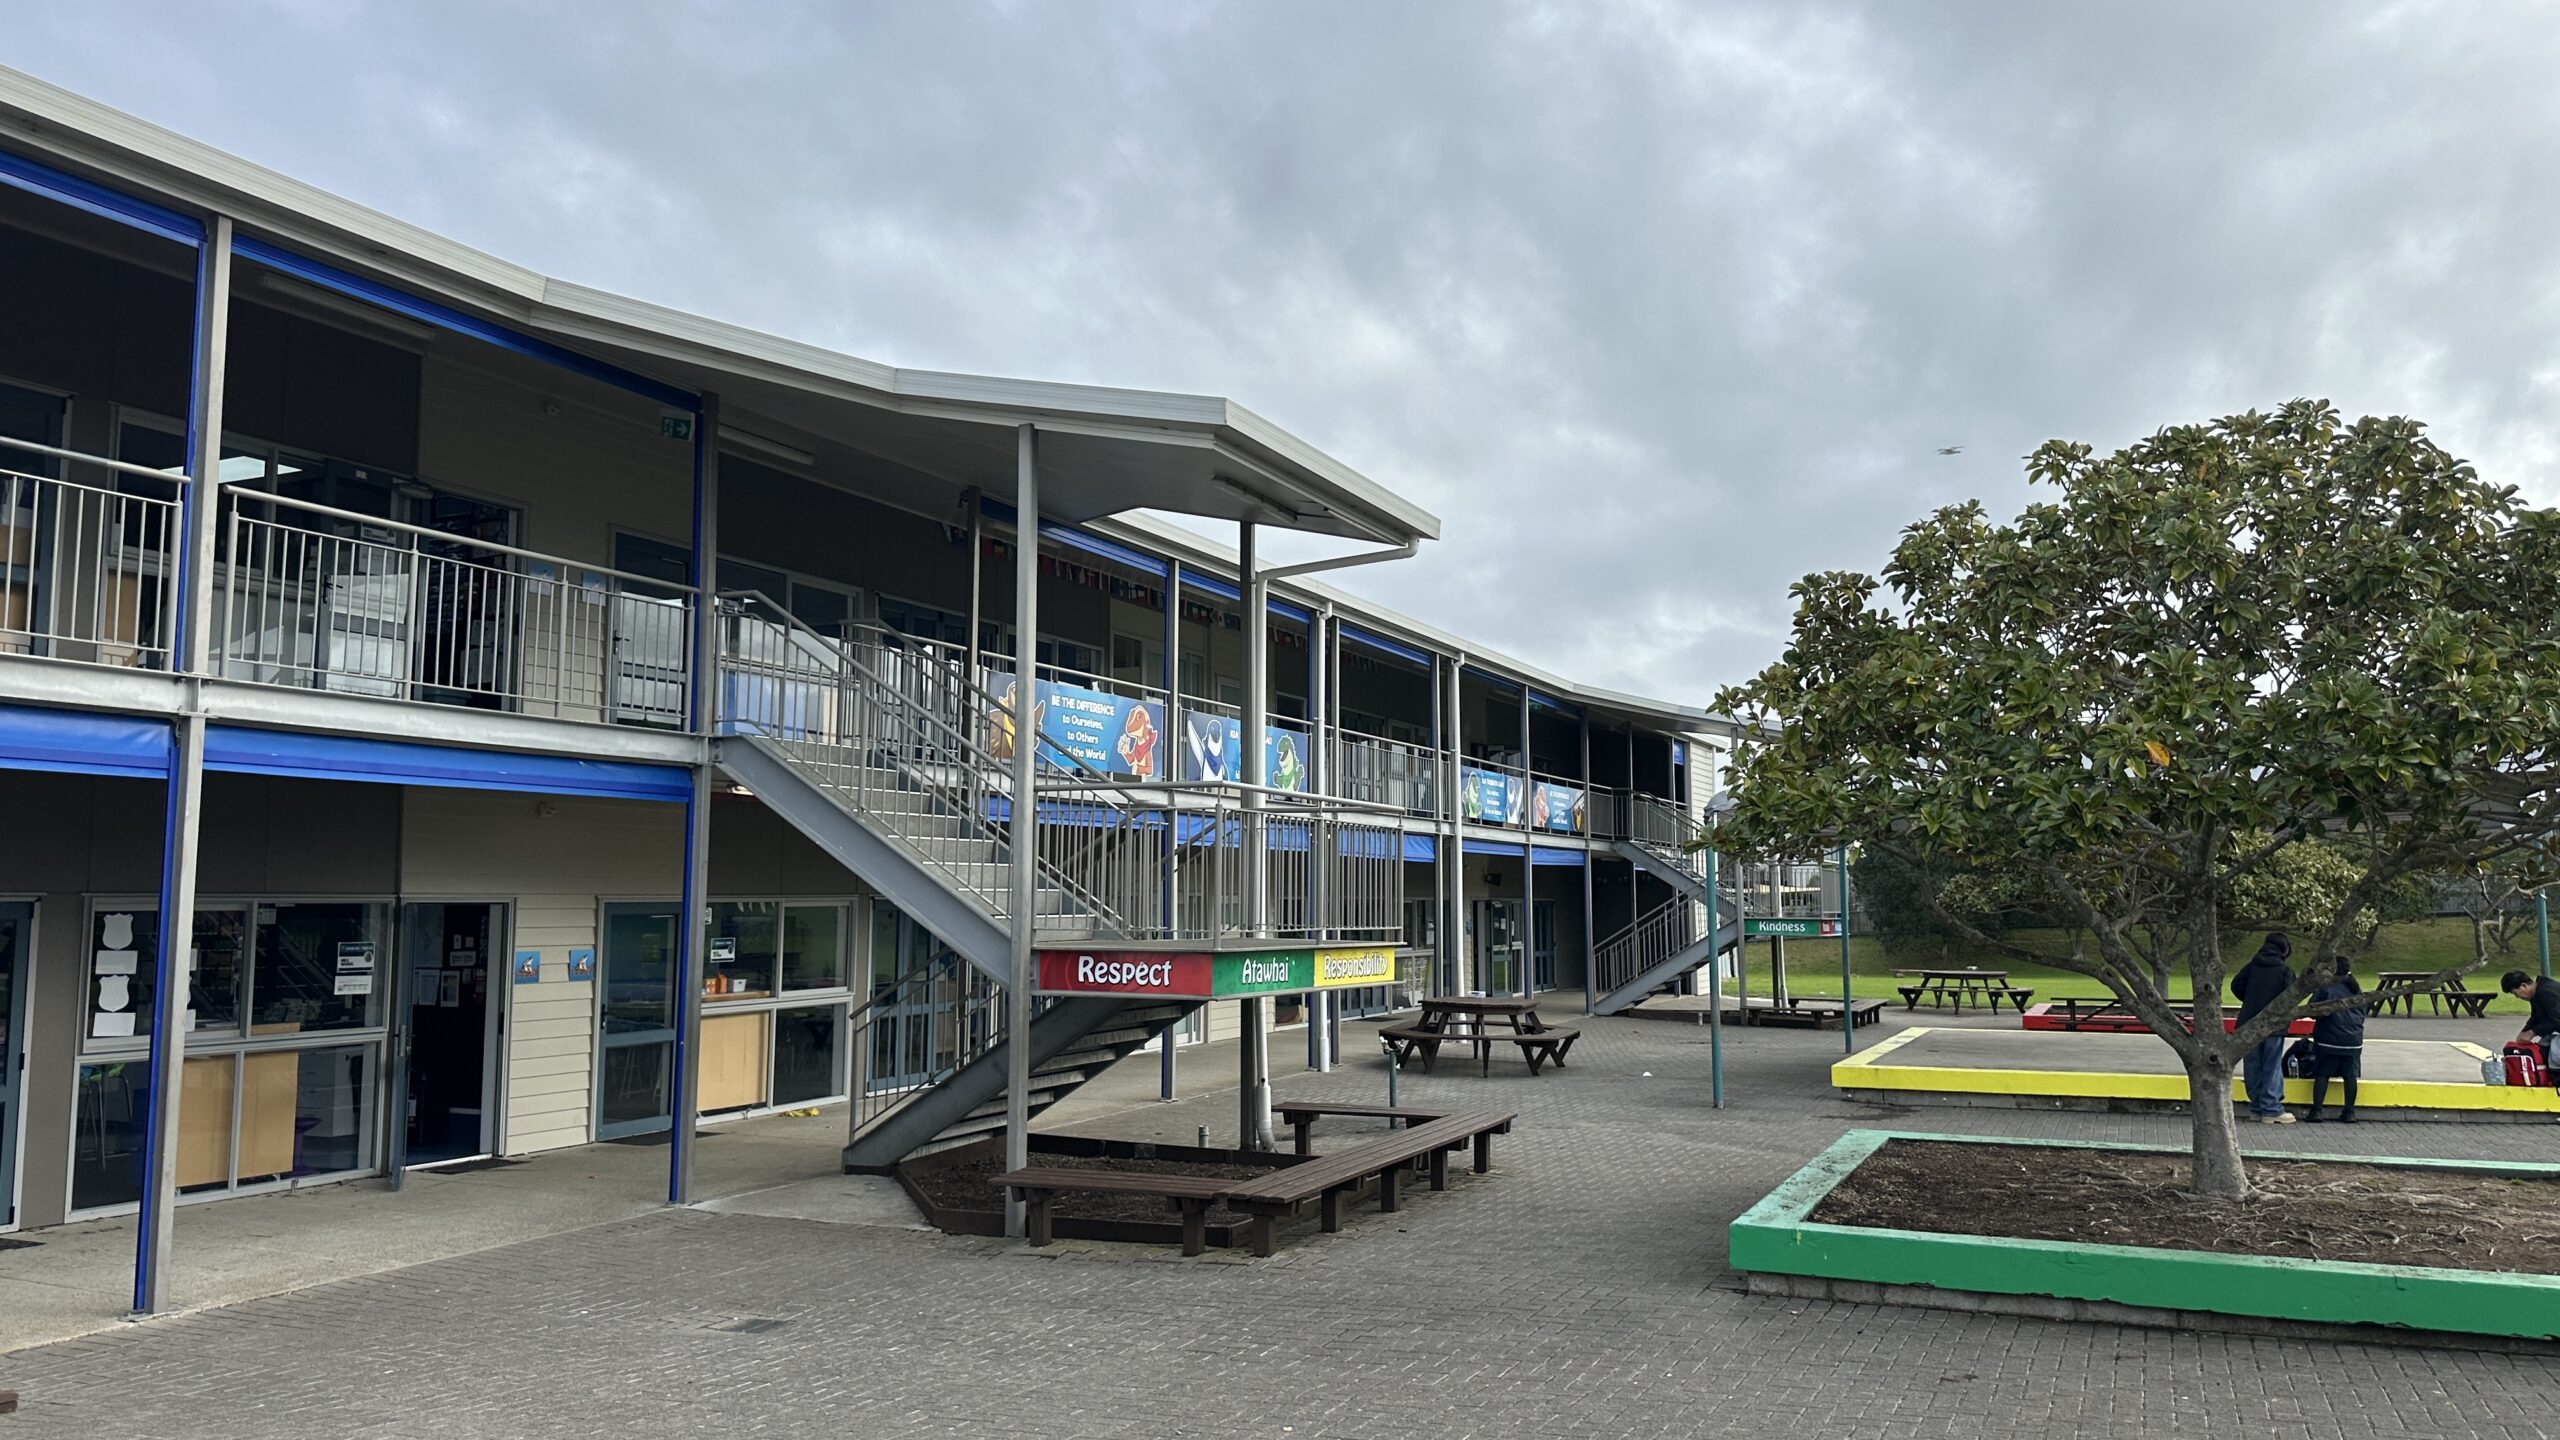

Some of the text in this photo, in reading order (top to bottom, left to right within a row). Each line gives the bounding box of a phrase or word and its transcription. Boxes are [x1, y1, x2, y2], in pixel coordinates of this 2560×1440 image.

[1051, 694, 1115, 717] BE THE DIFFERENCE
[1062, 713, 1071, 724] to
[1067, 731, 1099, 744] to Others
[1072, 746, 1085, 758] the
[1085, 747, 1106, 761] World
[1759, 921, 1806, 932] Kindness
[1077, 955, 1172, 987] Respect
[1242, 957, 1289, 984] Atawhai
[1324, 952, 1389, 980] Responsibility
